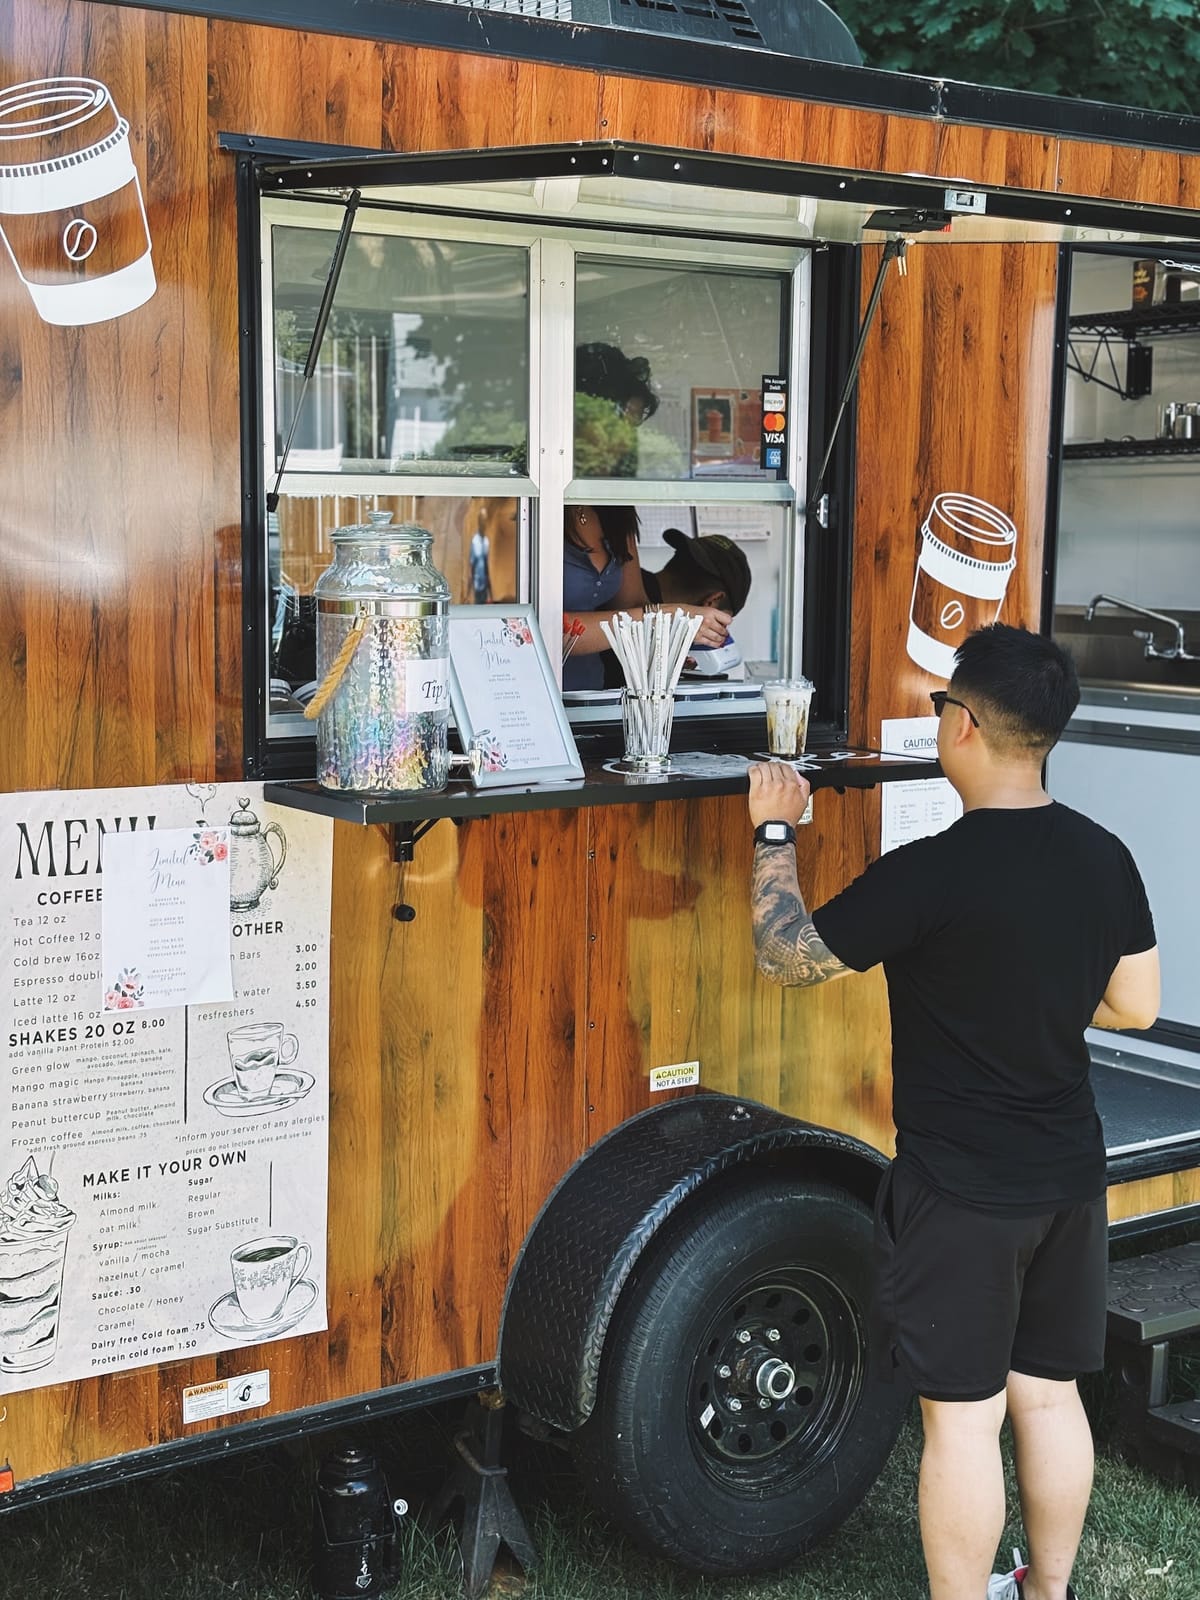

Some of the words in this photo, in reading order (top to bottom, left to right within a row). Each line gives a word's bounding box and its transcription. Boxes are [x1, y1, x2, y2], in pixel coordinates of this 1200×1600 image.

[764, 433, 785, 443] VISA
[421, 680, 443, 704] Tip
[15, 816, 156, 879] ME
[37, 888, 102, 906] COFFEE
[13, 917, 33, 926] Tea
[38, 915, 49, 925] 12
[53, 916, 67, 924] oz
[232, 920, 284, 937] OTHER
[13, 937, 33, 947] Hot
[38, 934, 75, 945] Coffee
[80, 931, 90, 941] 12
[94, 932, 101, 940] o
[295, 943, 317, 953] 3.00
[13, 956, 39, 967] Cold
[44, 955, 71, 965] brew
[76, 952, 100, 962] 16oz
[239, 951, 261, 960] Bars
[295, 962, 317, 972] 2.00
[13, 975, 64, 987] Espresso
[68, 970, 103, 982] doubl
[296, 980, 317, 990] 3.50
[243, 987, 271, 997] water
[13, 997, 43, 1007] Latte
[47, 994, 58, 1004] 12
[63, 994, 76, 1002] oz
[295, 998, 317, 1008] 4.50
[13, 1016, 37, 1027] Iced
[42, 1013, 68, 1024] latte
[73, 1011, 84, 1021] 16
[88, 1011, 101, 1019] oz
[198, 1007, 255, 1021] resfreshers
[9, 1027, 78, 1047] SHAKES
[85, 1024, 105, 1039] 20
[112, 1021, 136, 1035] OZ
[141, 1018, 165, 1029] 8.00
[9, 1049, 24, 1059] add
[27, 1046, 54, 1056] vanilla
[56, 1044, 78, 1053] Plant
[80, 1040, 110, 1050] Protein
[112, 1037, 135, 1047] $2.00
[140, 1055, 163, 1063] banana
[12, 1065, 42, 1075] Green
[46, 1061, 70, 1072] glow
[661, 1066, 694, 1078] CAUTION
[12, 1083, 45, 1093] Mango
[49, 1078, 79, 1089] magic
[656, 1080, 669, 1088] NOT
[677, 1076, 693, 1084] STEP
[11, 1100, 49, 1111] Banana
[52, 1092, 108, 1106] strawberry
[153, 1102, 176, 1110] almond
[11, 1118, 47, 1129] Peanut
[51, 1111, 101, 1124] buttercup
[123, 1111, 154, 1120] chocolate
[153, 1119, 180, 1128] chocolate
[210, 1128, 229, 1139] your
[232, 1124, 259, 1135] server
[262, 1121, 271, 1130] of
[274, 1120, 289, 1129] any
[291, 1114, 326, 1126] alergies
[11, 1136, 47, 1147] Frozen
[50, 1131, 83, 1142] coffee
[63, 1141, 86, 1149] ground
[87, 1137, 116, 1146] espresso
[185, 1147, 206, 1156] prices
[231, 1139, 256, 1148] include
[257, 1136, 274, 1144] sales
[83, 1168, 130, 1187] MAKE
[137, 1165, 152, 1180] IT
[158, 1157, 202, 1176] YOUR
[209, 1150, 247, 1167] OWN
[188, 1176, 214, 1186] Sugar
[93, 1191, 121, 1201] Milks:
[188, 1190, 221, 1203] Regular
[99, 1204, 135, 1217] Almond
[187, 1208, 215, 1219] Brown
[99, 1225, 114, 1234] oat
[118, 1221, 137, 1231] milk
[187, 1224, 212, 1236] Sugar
[215, 1216, 260, 1231] Substitute
[92, 1240, 122, 1252] Syrup:
[99, 1256, 130, 1267] vanilla
[141, 1249, 170, 1260] mocha
[98, 1270, 139, 1283] hazelnut
[150, 1261, 185, 1275] caramel
[92, 1289, 123, 1300] Sauce:
[126, 1285, 141, 1295] .30
[98, 1302, 145, 1316] Chocolate
[156, 1295, 184, 1306] Honey
[98, 1319, 135, 1332] Caramel
[91, 1339, 116, 1350] Dairy
[119, 1334, 138, 1345] free
[141, 1330, 162, 1340] Cold
[166, 1326, 189, 1336] foam
[192, 1322, 205, 1331] .75
[91, 1353, 125, 1366] Protein
[129, 1348, 149, 1359] cold
[152, 1345, 175, 1354] foam
[178, 1339, 197, 1349] 1.50
[193, 1383, 224, 1394] WARNING
